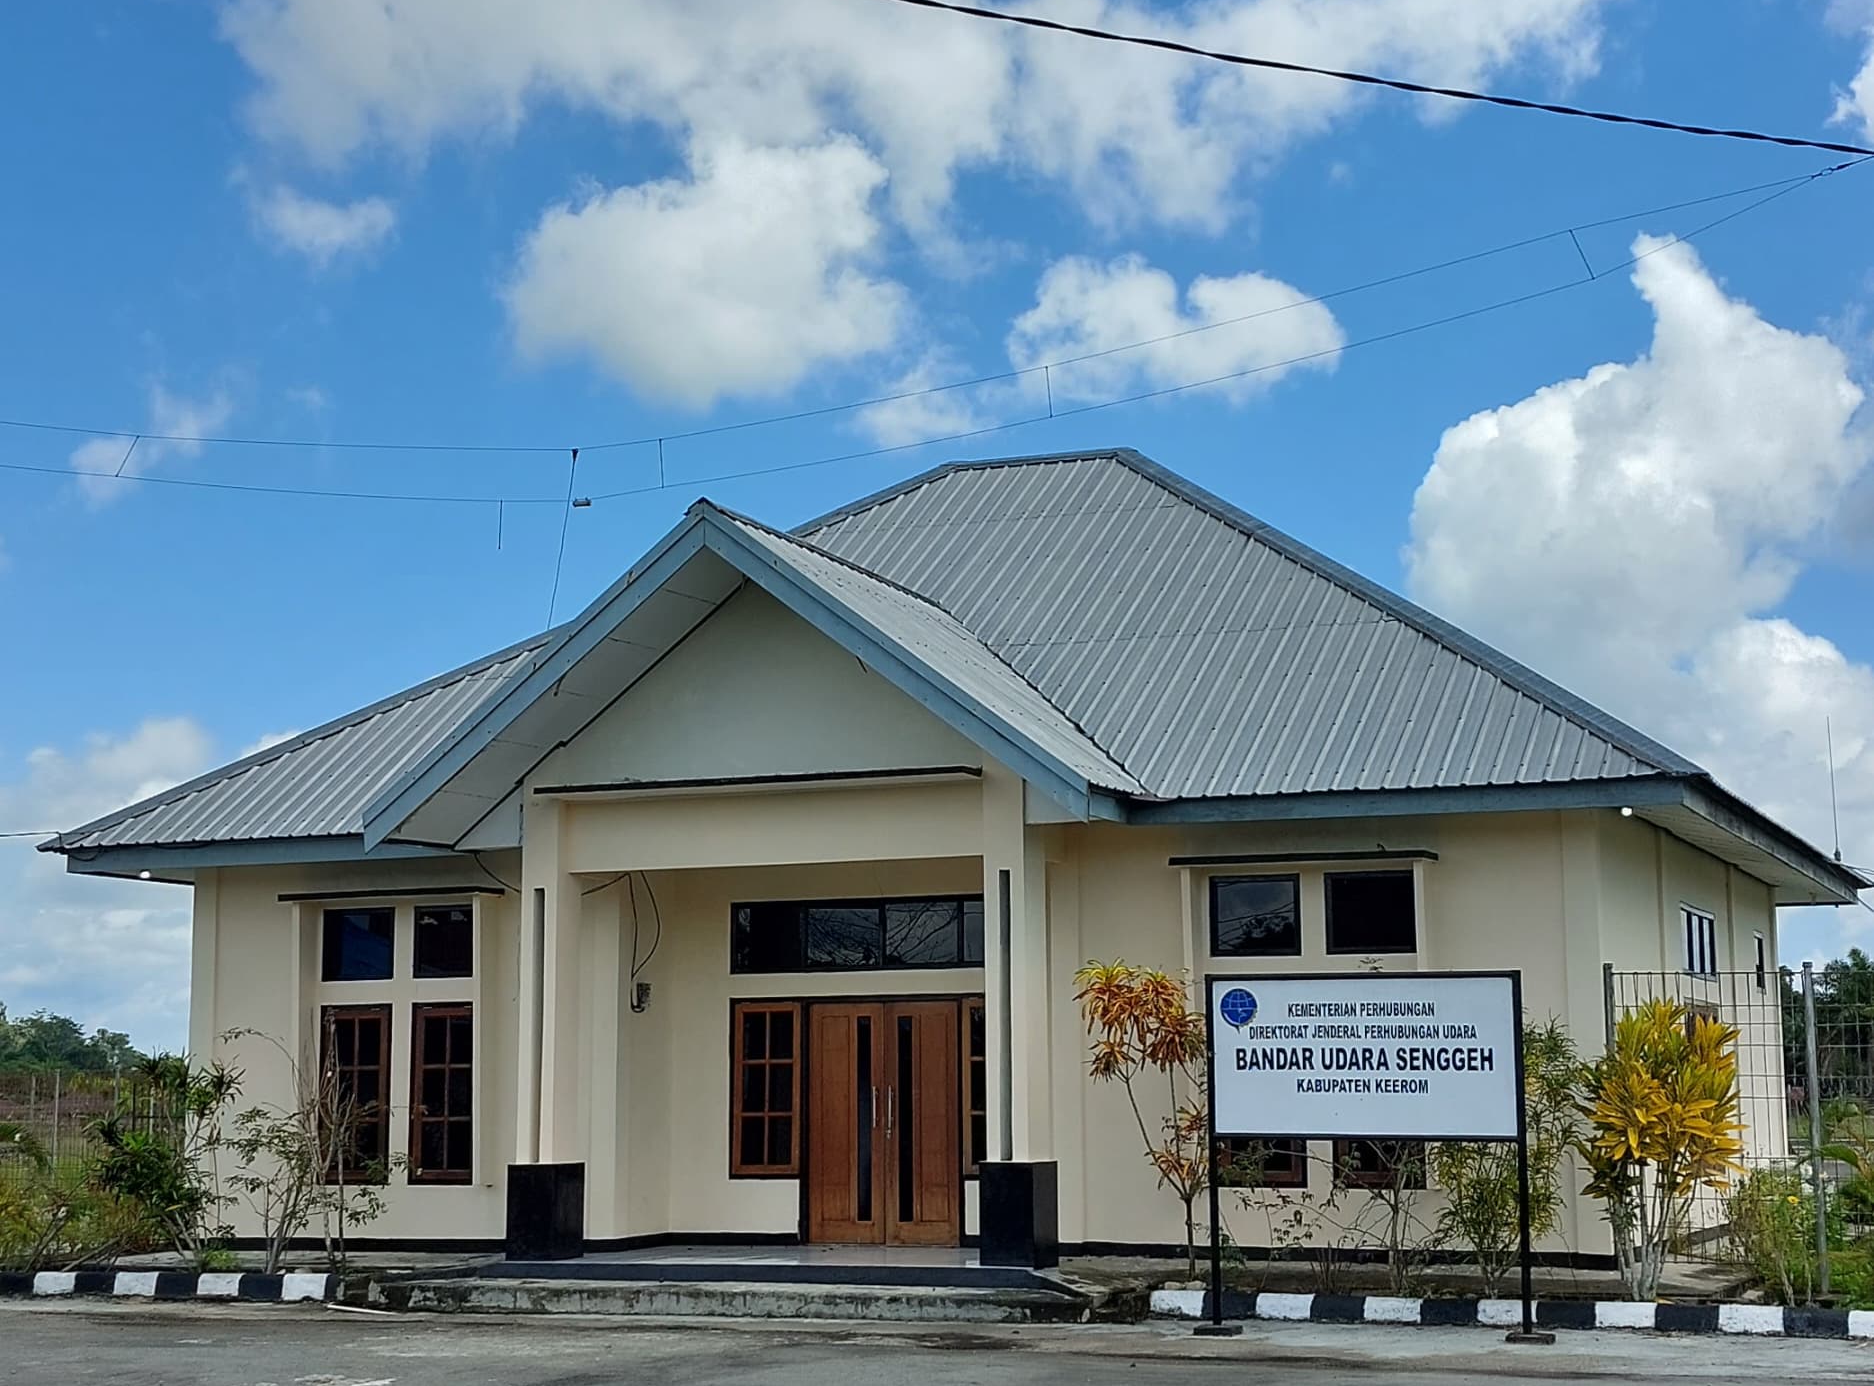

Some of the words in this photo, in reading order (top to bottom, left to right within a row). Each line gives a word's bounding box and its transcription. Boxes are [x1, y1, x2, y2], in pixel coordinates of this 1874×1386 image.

[1287, 1002, 1357, 1018] KEMENTERIAN
[1360, 1002, 1435, 1017] PERHUBUNGAN
[1249, 1025, 1309, 1040] DIREKTORAT
[1311, 1025, 1362, 1040] JENDERAL
[1364, 1024, 1440, 1040] PERHUBUNGAN
[1442, 1024, 1477, 1039] UDARA
[1235, 1047, 1314, 1072] BANDAR
[1320, 1047, 1390, 1072] UDARA
[1395, 1047, 1494, 1072] SENGGEH
[1296, 1078, 1371, 1094] KABUPATEN
[1374, 1078, 1429, 1094] KEEROM
